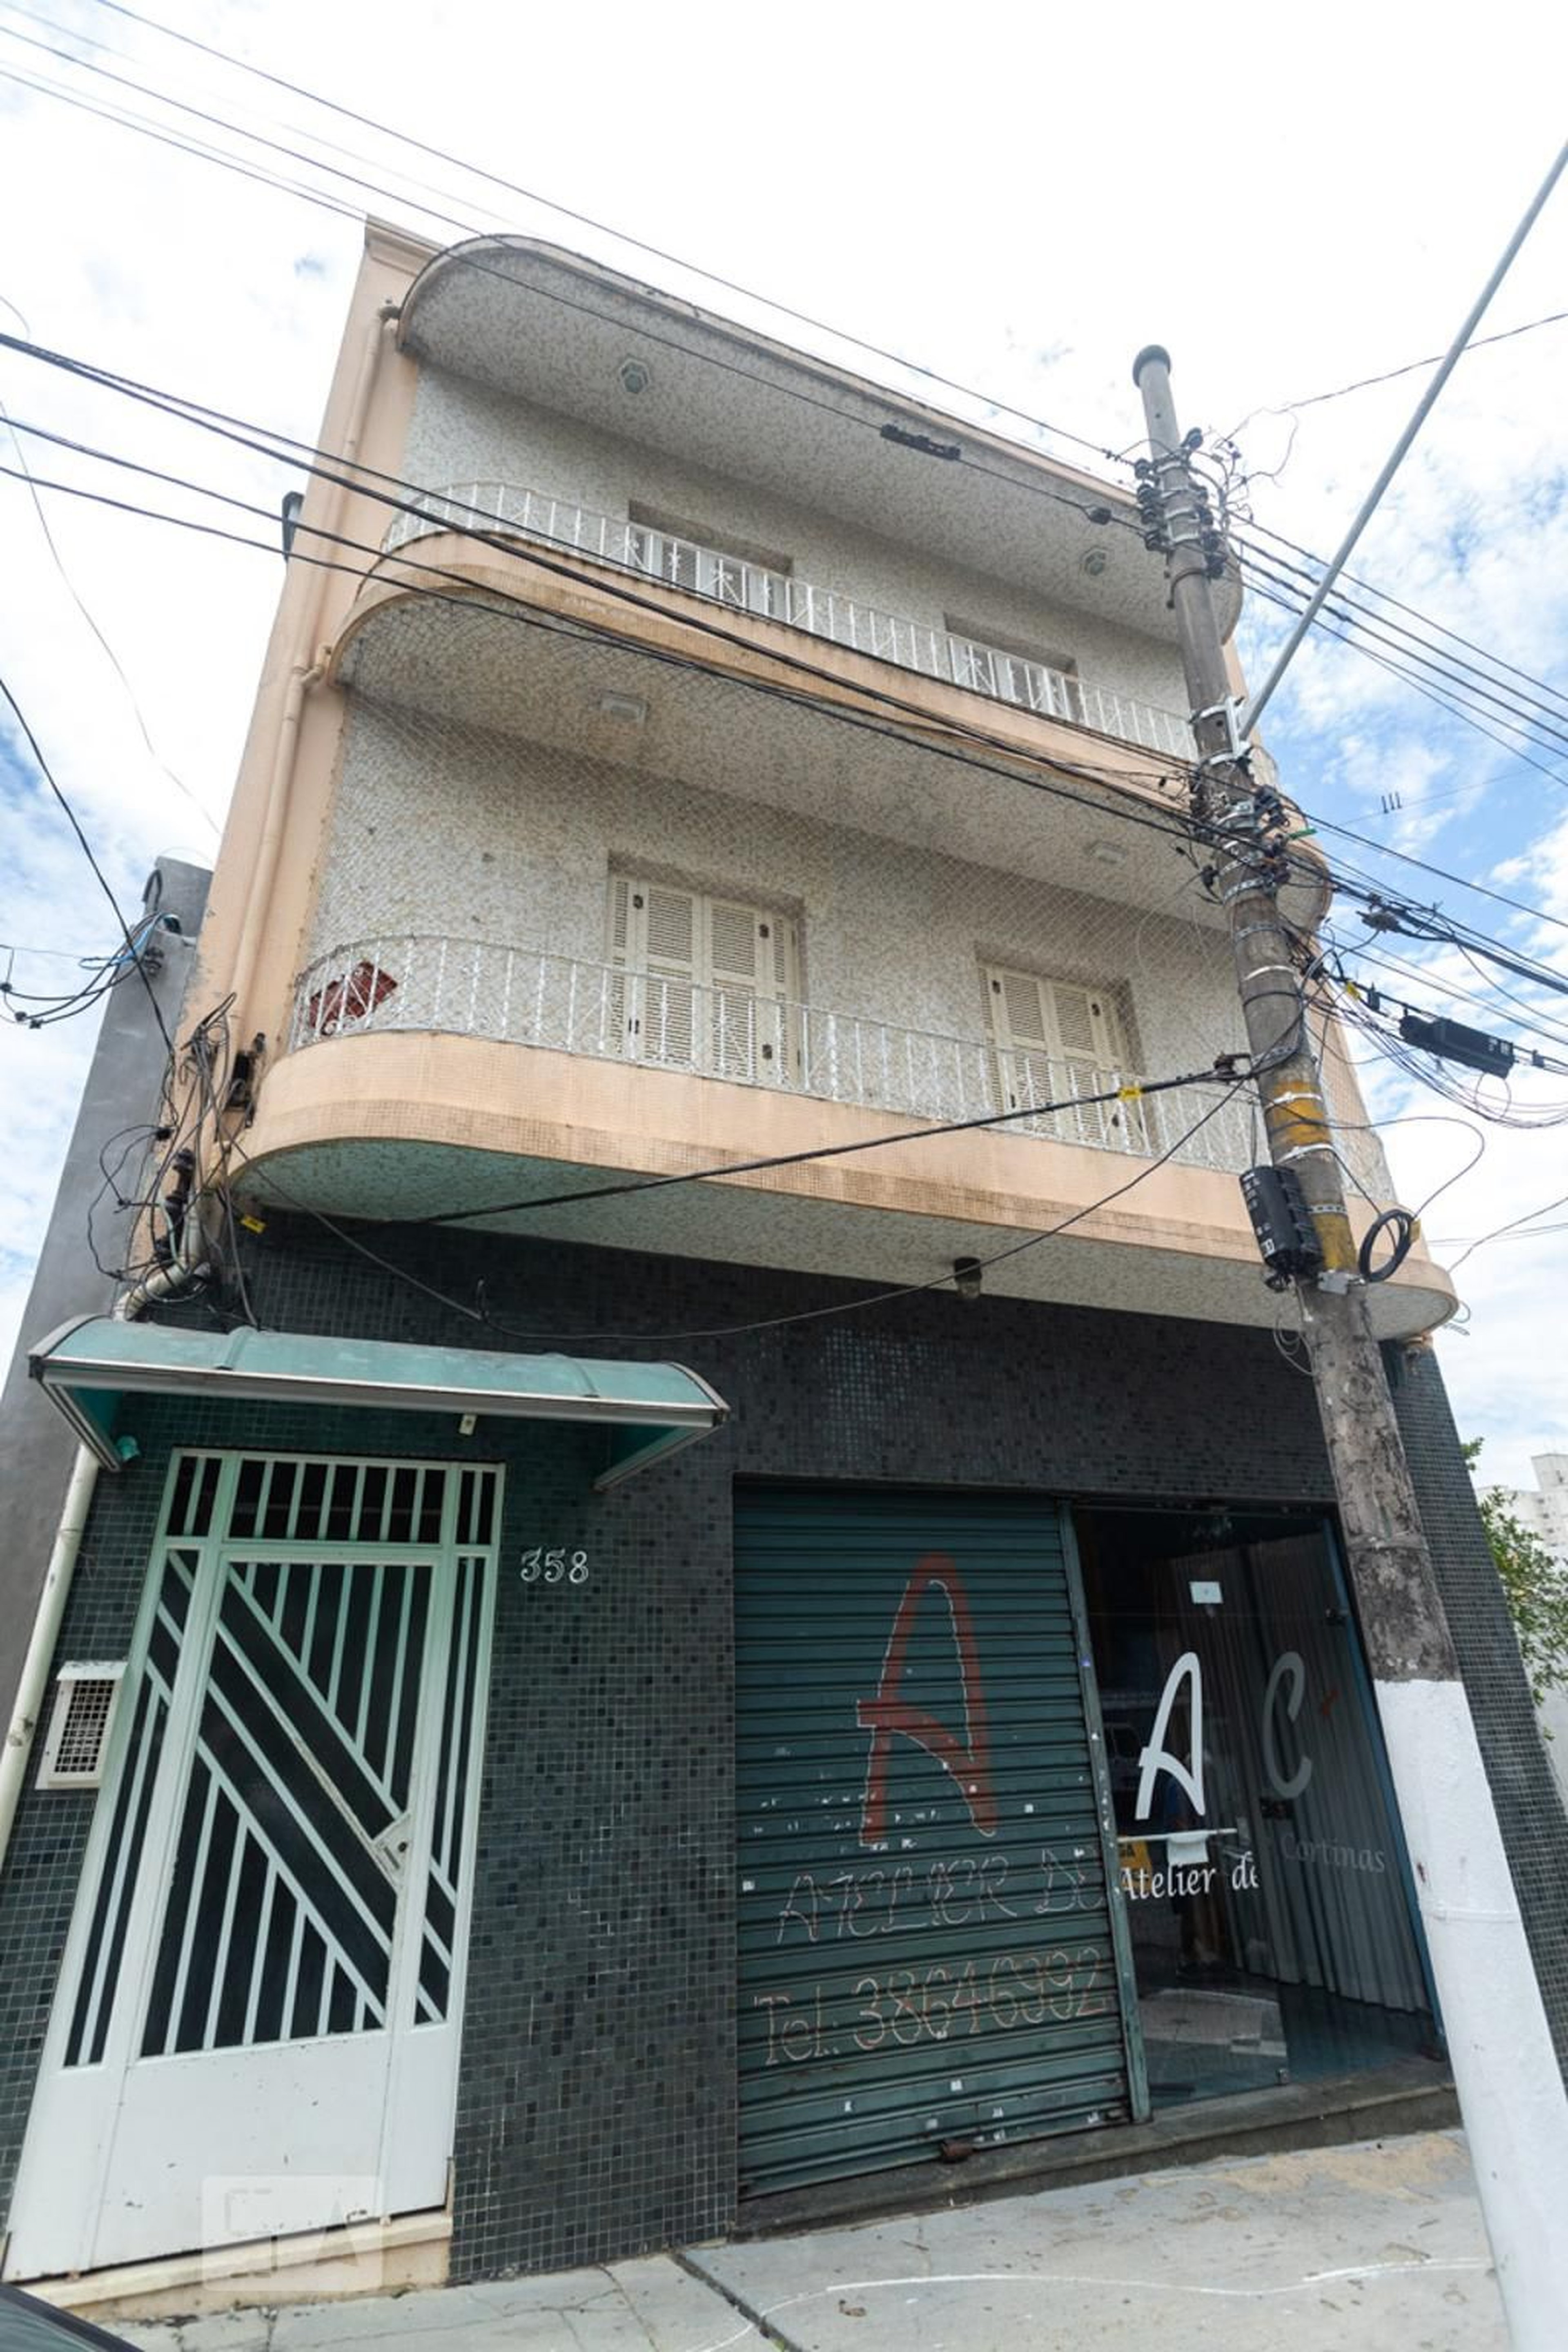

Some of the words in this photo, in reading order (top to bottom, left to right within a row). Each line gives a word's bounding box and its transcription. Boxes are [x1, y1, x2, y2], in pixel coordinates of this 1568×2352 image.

[521, 1547, 589, 1584] 358
[1135, 1652, 1205, 1820] A
[1263, 1651, 1312, 1798] C
[1121, 1865, 1216, 1900] Atelier
[1281, 1833, 1385, 1873] Cortinas
